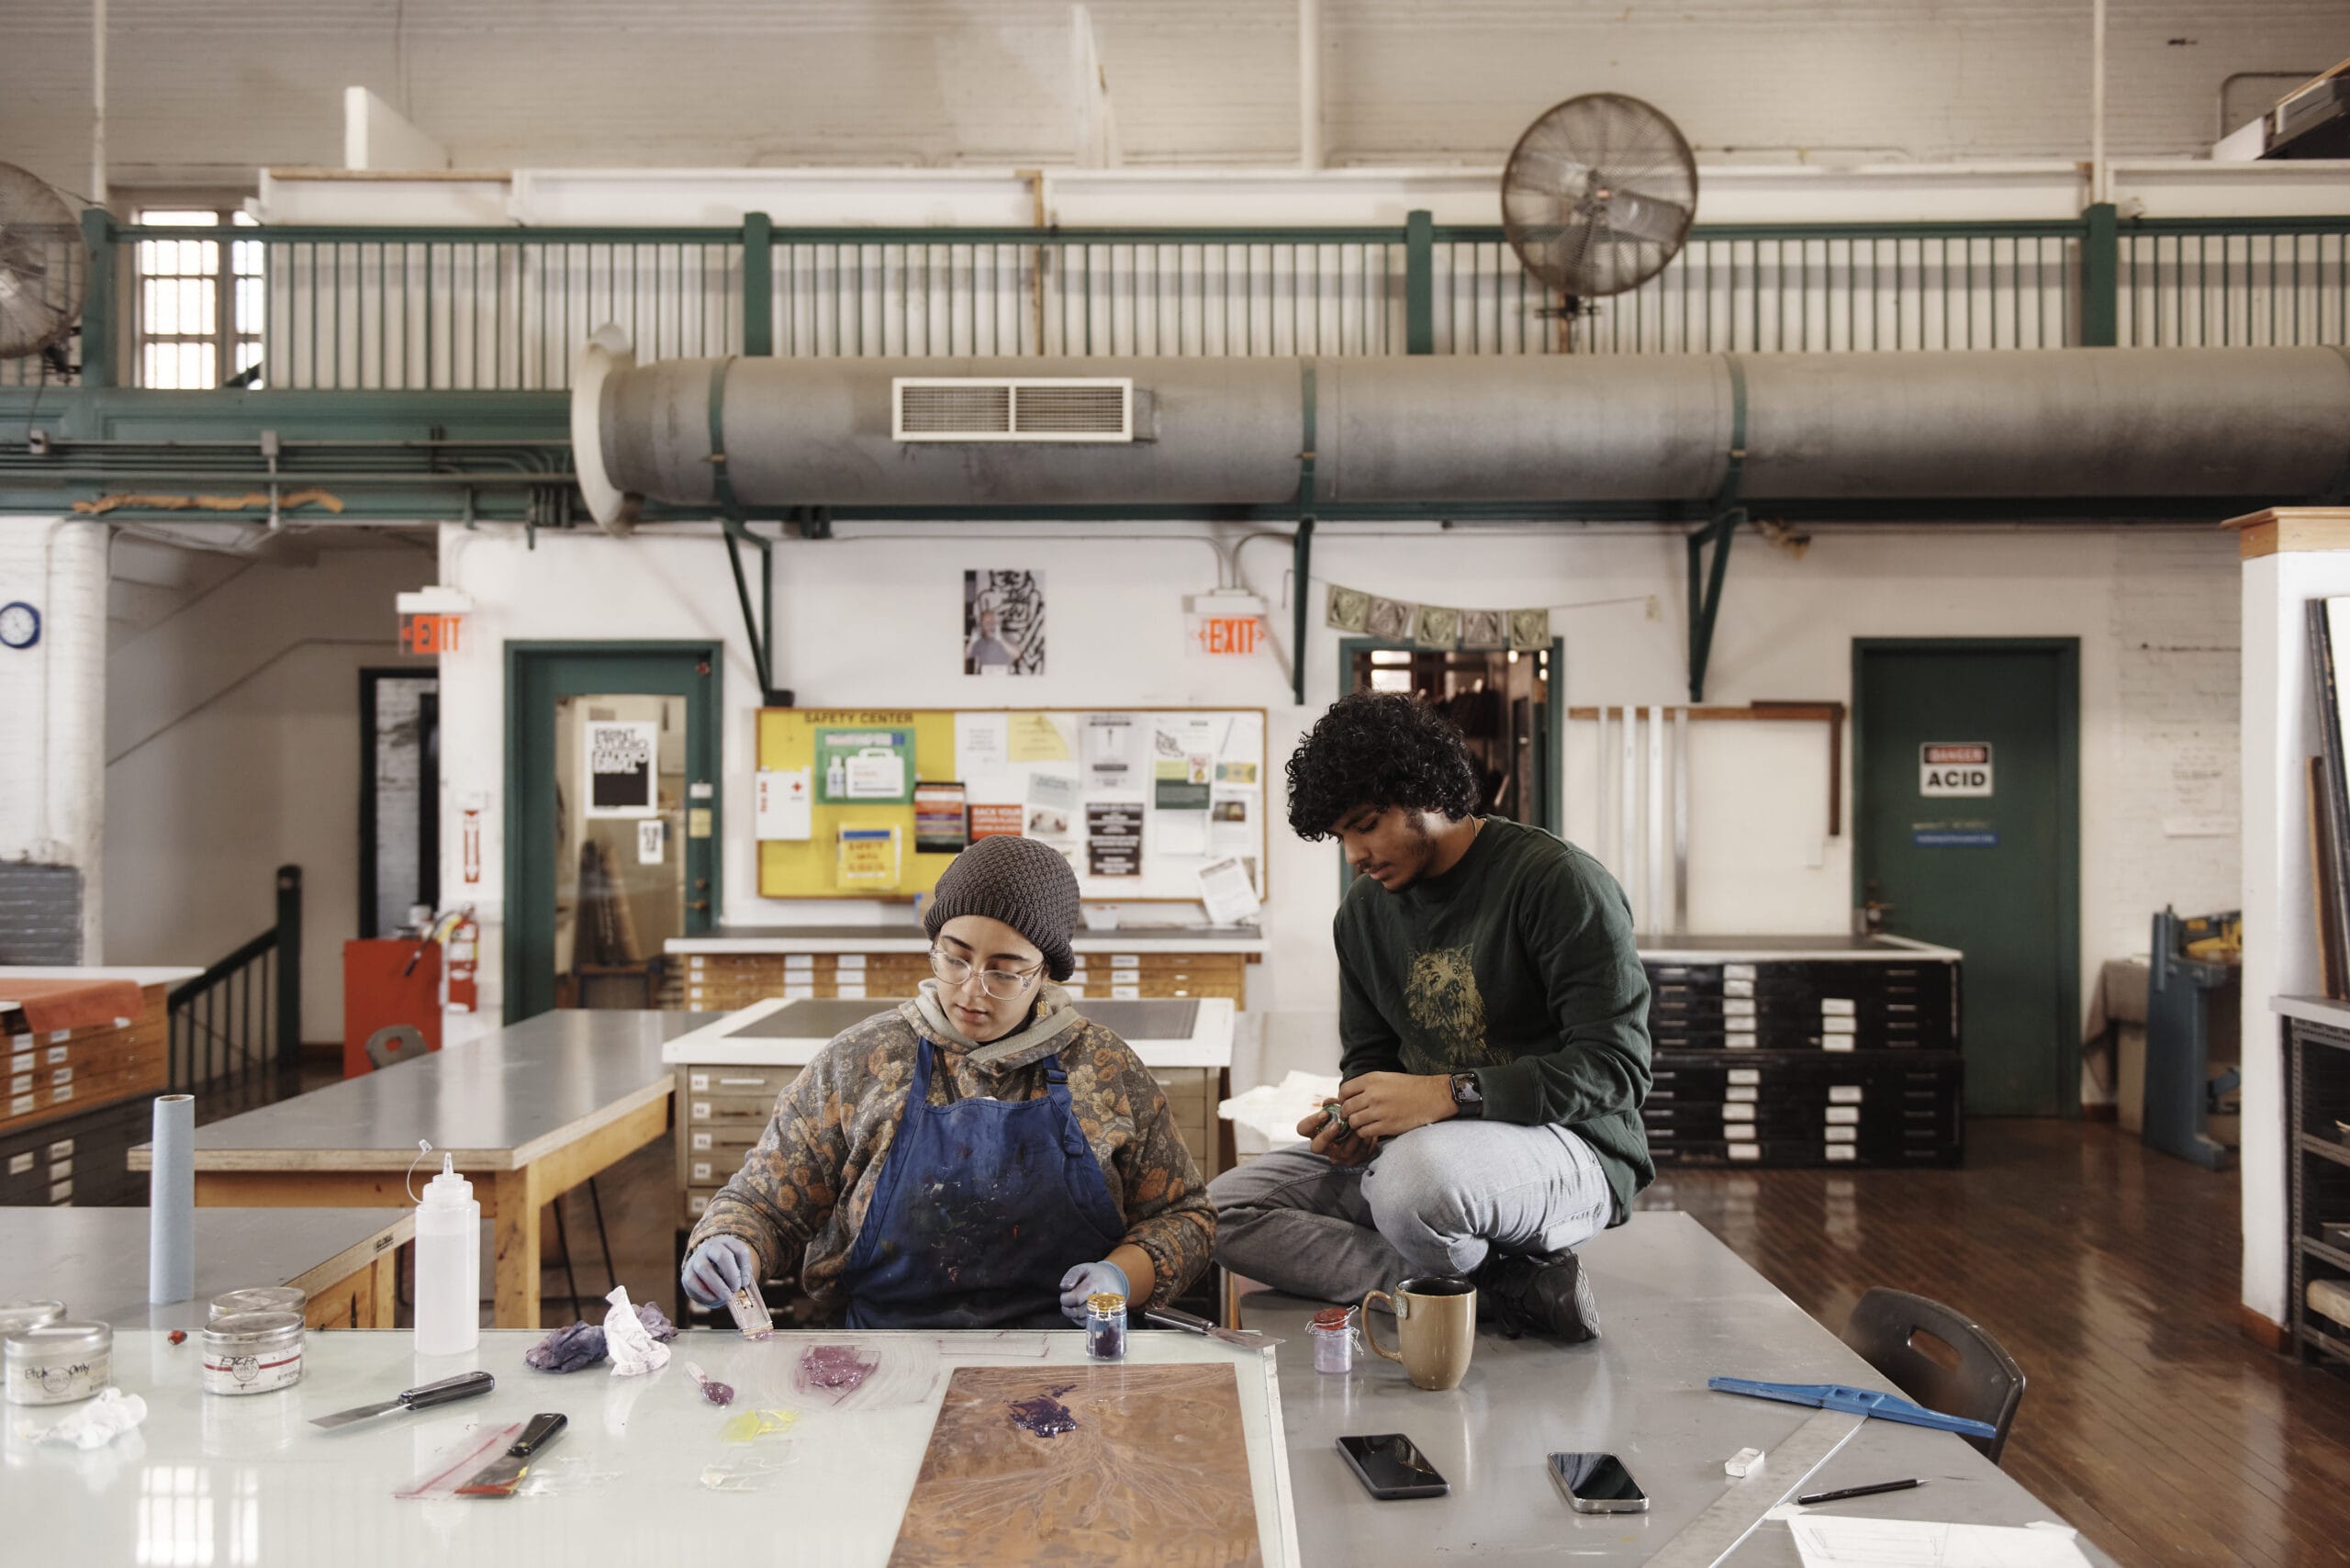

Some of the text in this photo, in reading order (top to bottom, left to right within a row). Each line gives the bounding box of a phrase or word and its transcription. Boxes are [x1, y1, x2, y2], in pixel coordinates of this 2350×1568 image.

[1209, 618, 1259, 654] EXIT
[803, 712, 913, 723] SAFETY CENTER
[1928, 772, 1986, 786] ACID
